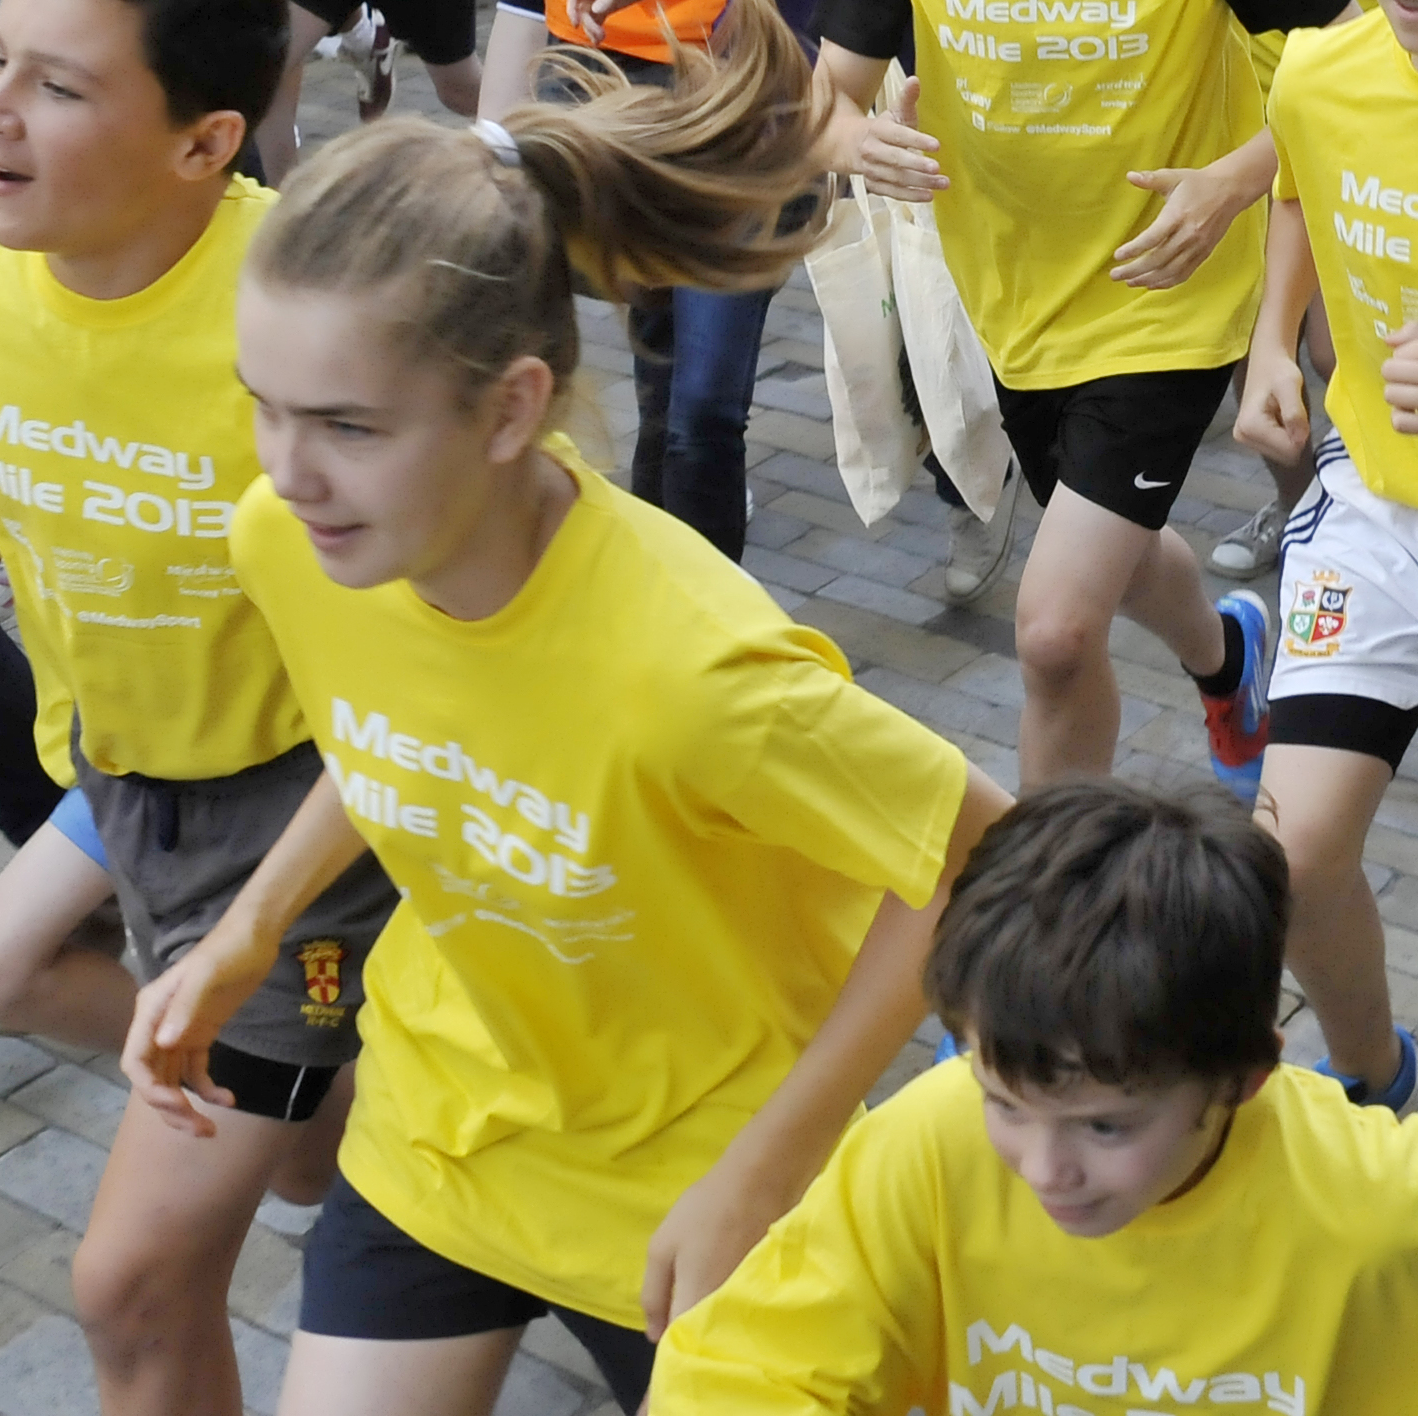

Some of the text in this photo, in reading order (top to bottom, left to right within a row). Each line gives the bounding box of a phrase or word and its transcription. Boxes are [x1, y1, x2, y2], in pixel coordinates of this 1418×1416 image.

[938, 24, 1149, 62] Mile 2013
[1334, 211, 1411, 263] Mile
[83, 480, 237, 538] 2013
[332, 696, 590, 854] Medway
[325, 752, 439, 838] Mile
[461, 804, 617, 898] 2013
[966, 1318, 1305, 1416] Medway
